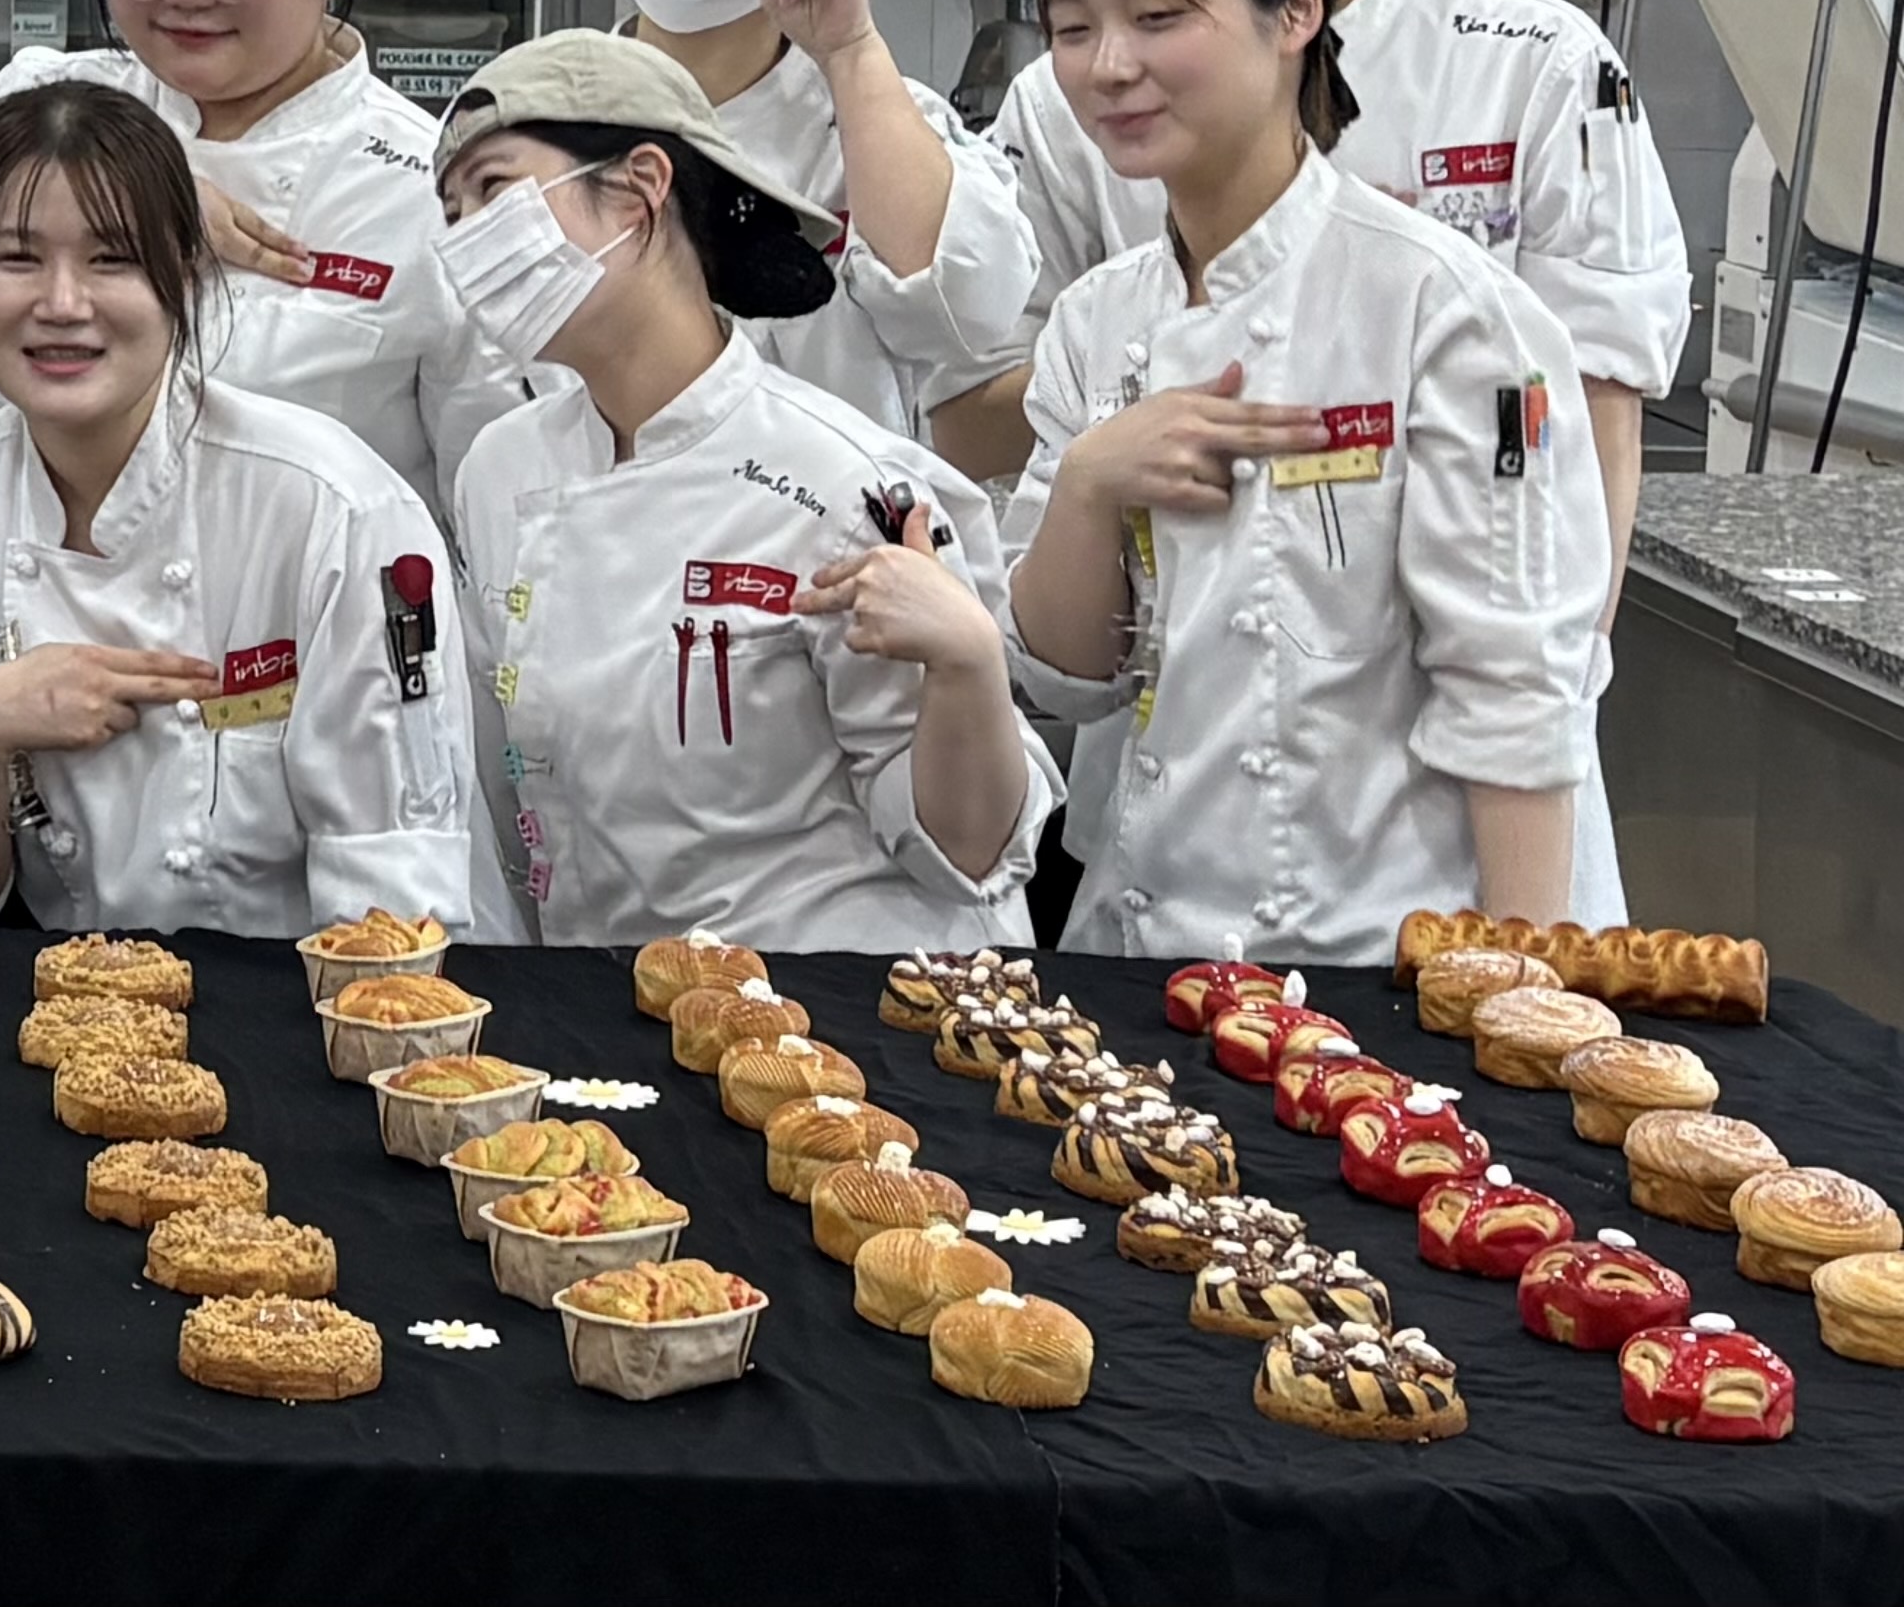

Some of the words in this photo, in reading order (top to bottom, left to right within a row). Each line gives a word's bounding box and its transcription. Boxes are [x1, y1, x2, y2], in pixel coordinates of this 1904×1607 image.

[1461, 146, 1511, 173] inb
[323, 258, 382, 295] inbp
[1336, 406, 1389, 437] inb
[723, 566, 787, 606] inbp
[233, 649, 297, 682] inbp
